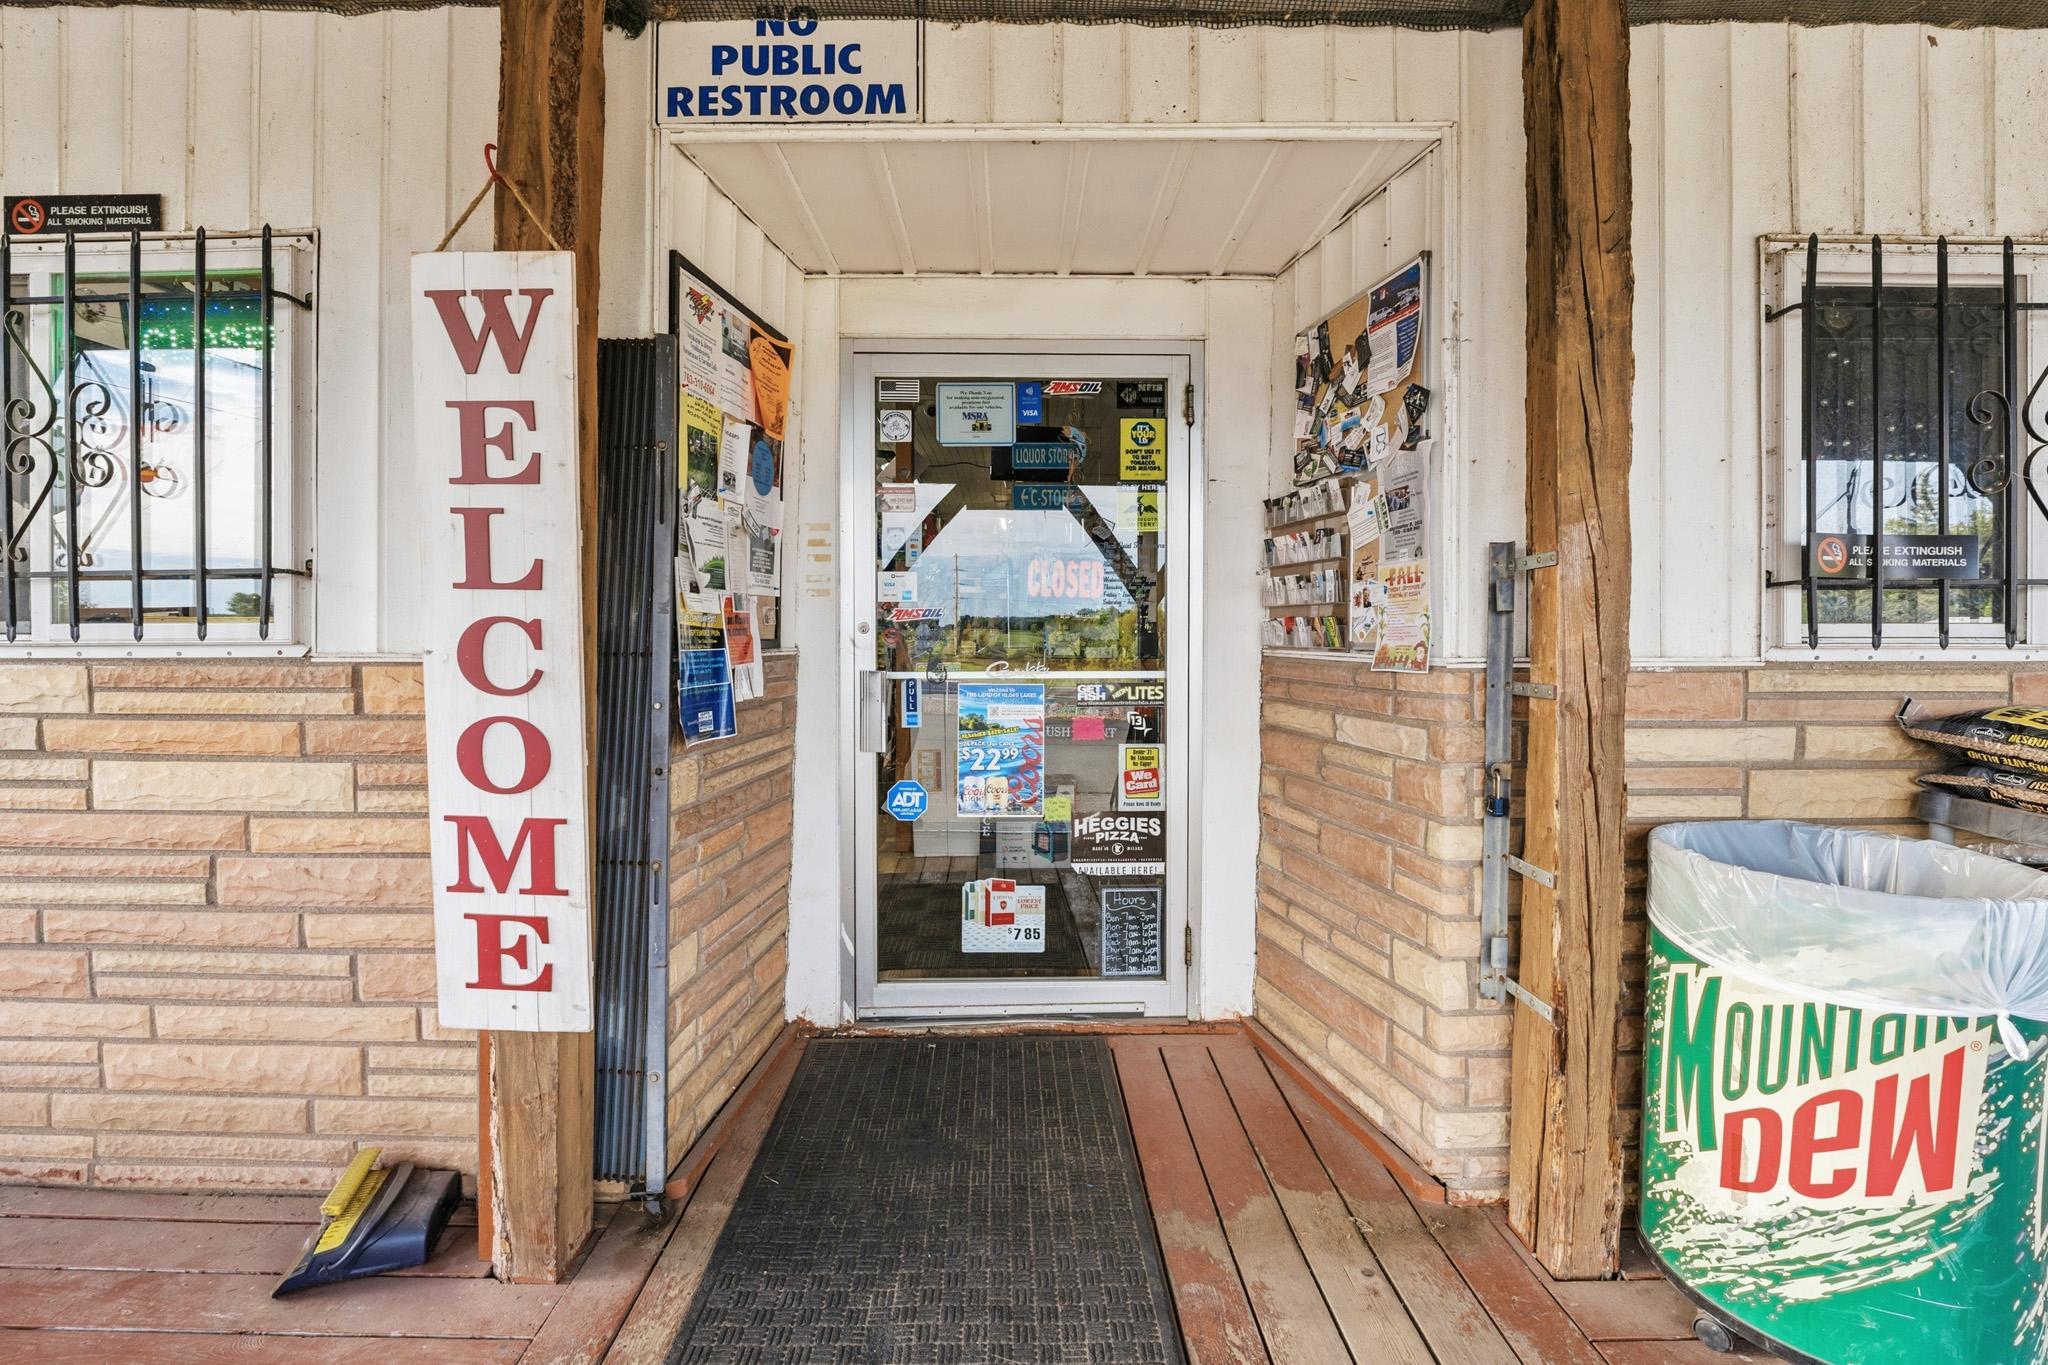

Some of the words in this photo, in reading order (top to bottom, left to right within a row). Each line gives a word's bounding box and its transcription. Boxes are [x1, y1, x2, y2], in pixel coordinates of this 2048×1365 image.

[711, 43, 862, 76] PUBLIC
[667, 83, 907, 117] RESTROOM
[50, 206, 87, 215] PLEASE
[91, 205, 148, 215] EXTINGUISH
[47, 218, 62, 226] ALL
[65, 217, 103, 226] SMOKING
[106, 217, 152, 225] MATERIALS
[1047, 382, 1101, 394] AMSOIL
[962, 412, 989, 420] MSRA
[1022, 409, 1039, 417] VISA
[1132, 430, 1155, 438] YOUR
[1015, 448, 1047, 464] LIQUOR
[1852, 545, 1890, 556] PLEAE
[1895, 545, 1963, 556] EXTINGUISH
[1849, 558, 1864, 567] ALL
[1866, 558, 1909, 567] SOKING
[1912, 558, 1967, 567] MATERIALS
[1027, 558, 1105, 599] CLOSED
[1388, 564, 1422, 586] FALL
[891, 608, 944, 620] AMSOIL
[424, 288, 569, 992] WELCOME
[1077, 684, 1103, 693] GET
[1127, 685, 1164, 700] LITES
[1077, 692, 1106, 701] FISH
[1130, 716, 1142, 726] 13
[1130, 771, 1152, 780] We
[1126, 779, 1157, 791] Card
[891, 791, 924, 808] ADT
[1074, 814, 1161, 837] HEGGIES
[1095, 831, 1140, 844] PIZZA
[1078, 866, 1127, 875] AVAILABLE
[1131, 866, 1158, 875] HERE!
[1113, 891, 1147, 905] Hours
